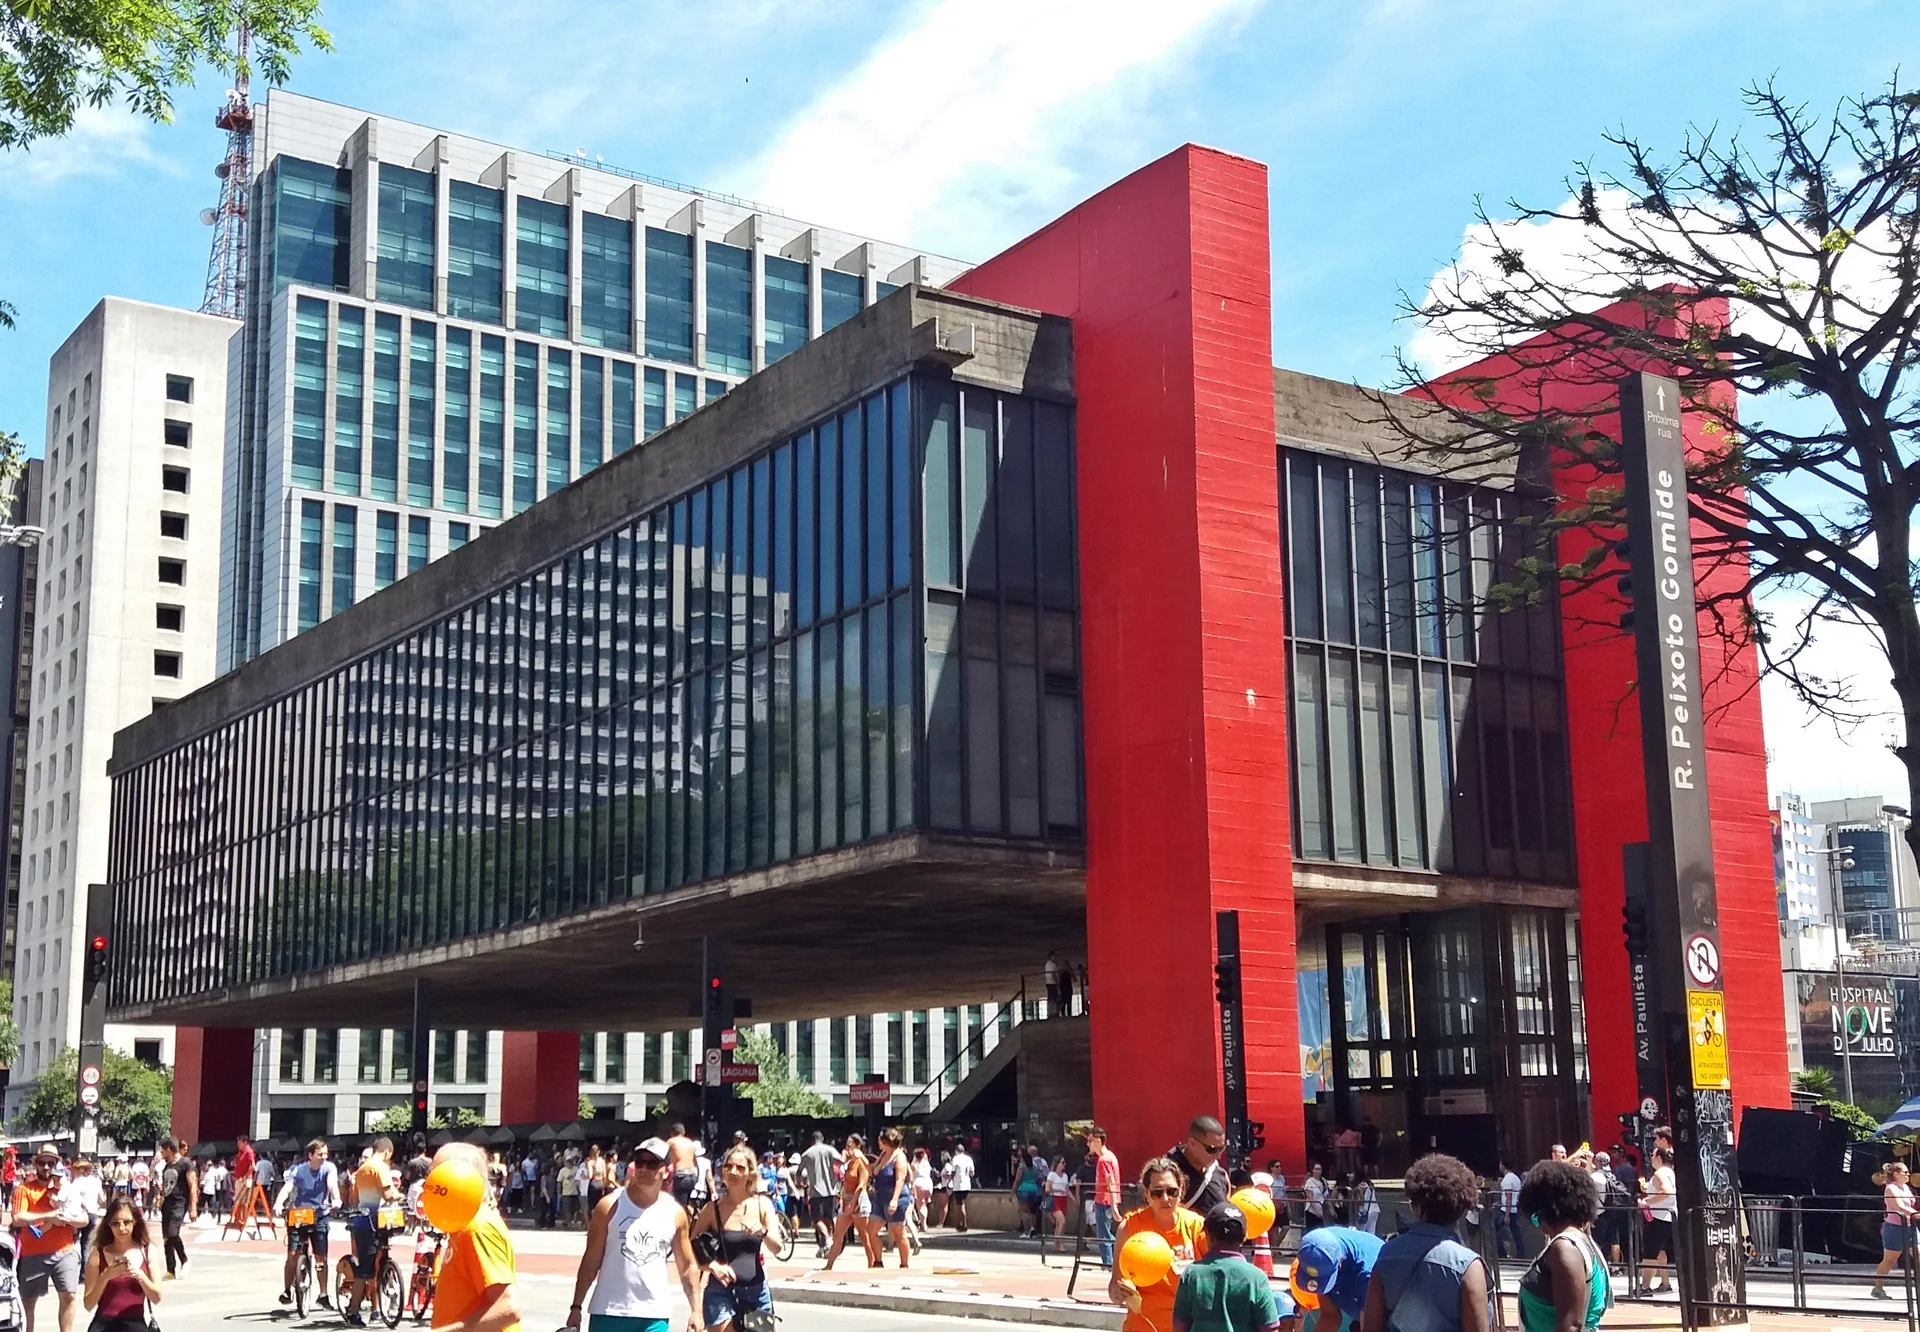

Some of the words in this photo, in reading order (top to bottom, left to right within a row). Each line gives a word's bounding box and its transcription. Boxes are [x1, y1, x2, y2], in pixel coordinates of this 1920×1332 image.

[1647, 411, 1679, 428] Próxima
[1658, 428, 1672, 438] rua
[1656, 470, 1681, 600] Gomide
[1669, 613, 1691, 749] Peixoto
[1675, 760, 1693, 790] R.
[1634, 964, 1647, 1034] Paulista
[1690, 996, 1722, 1007] CICLISTA
[1830, 987, 1891, 1004] HOSPITAL
[1223, 1009, 1233, 1068] Paulista
[1861, 1037, 1894, 1052] JULHO
[1638, 1038, 1649, 1061] Av.
[722, 1067, 758, 1077] LAGUNA
[432, 1184, 449, 1197] 30
[633, 1229, 654, 1246] NYC
